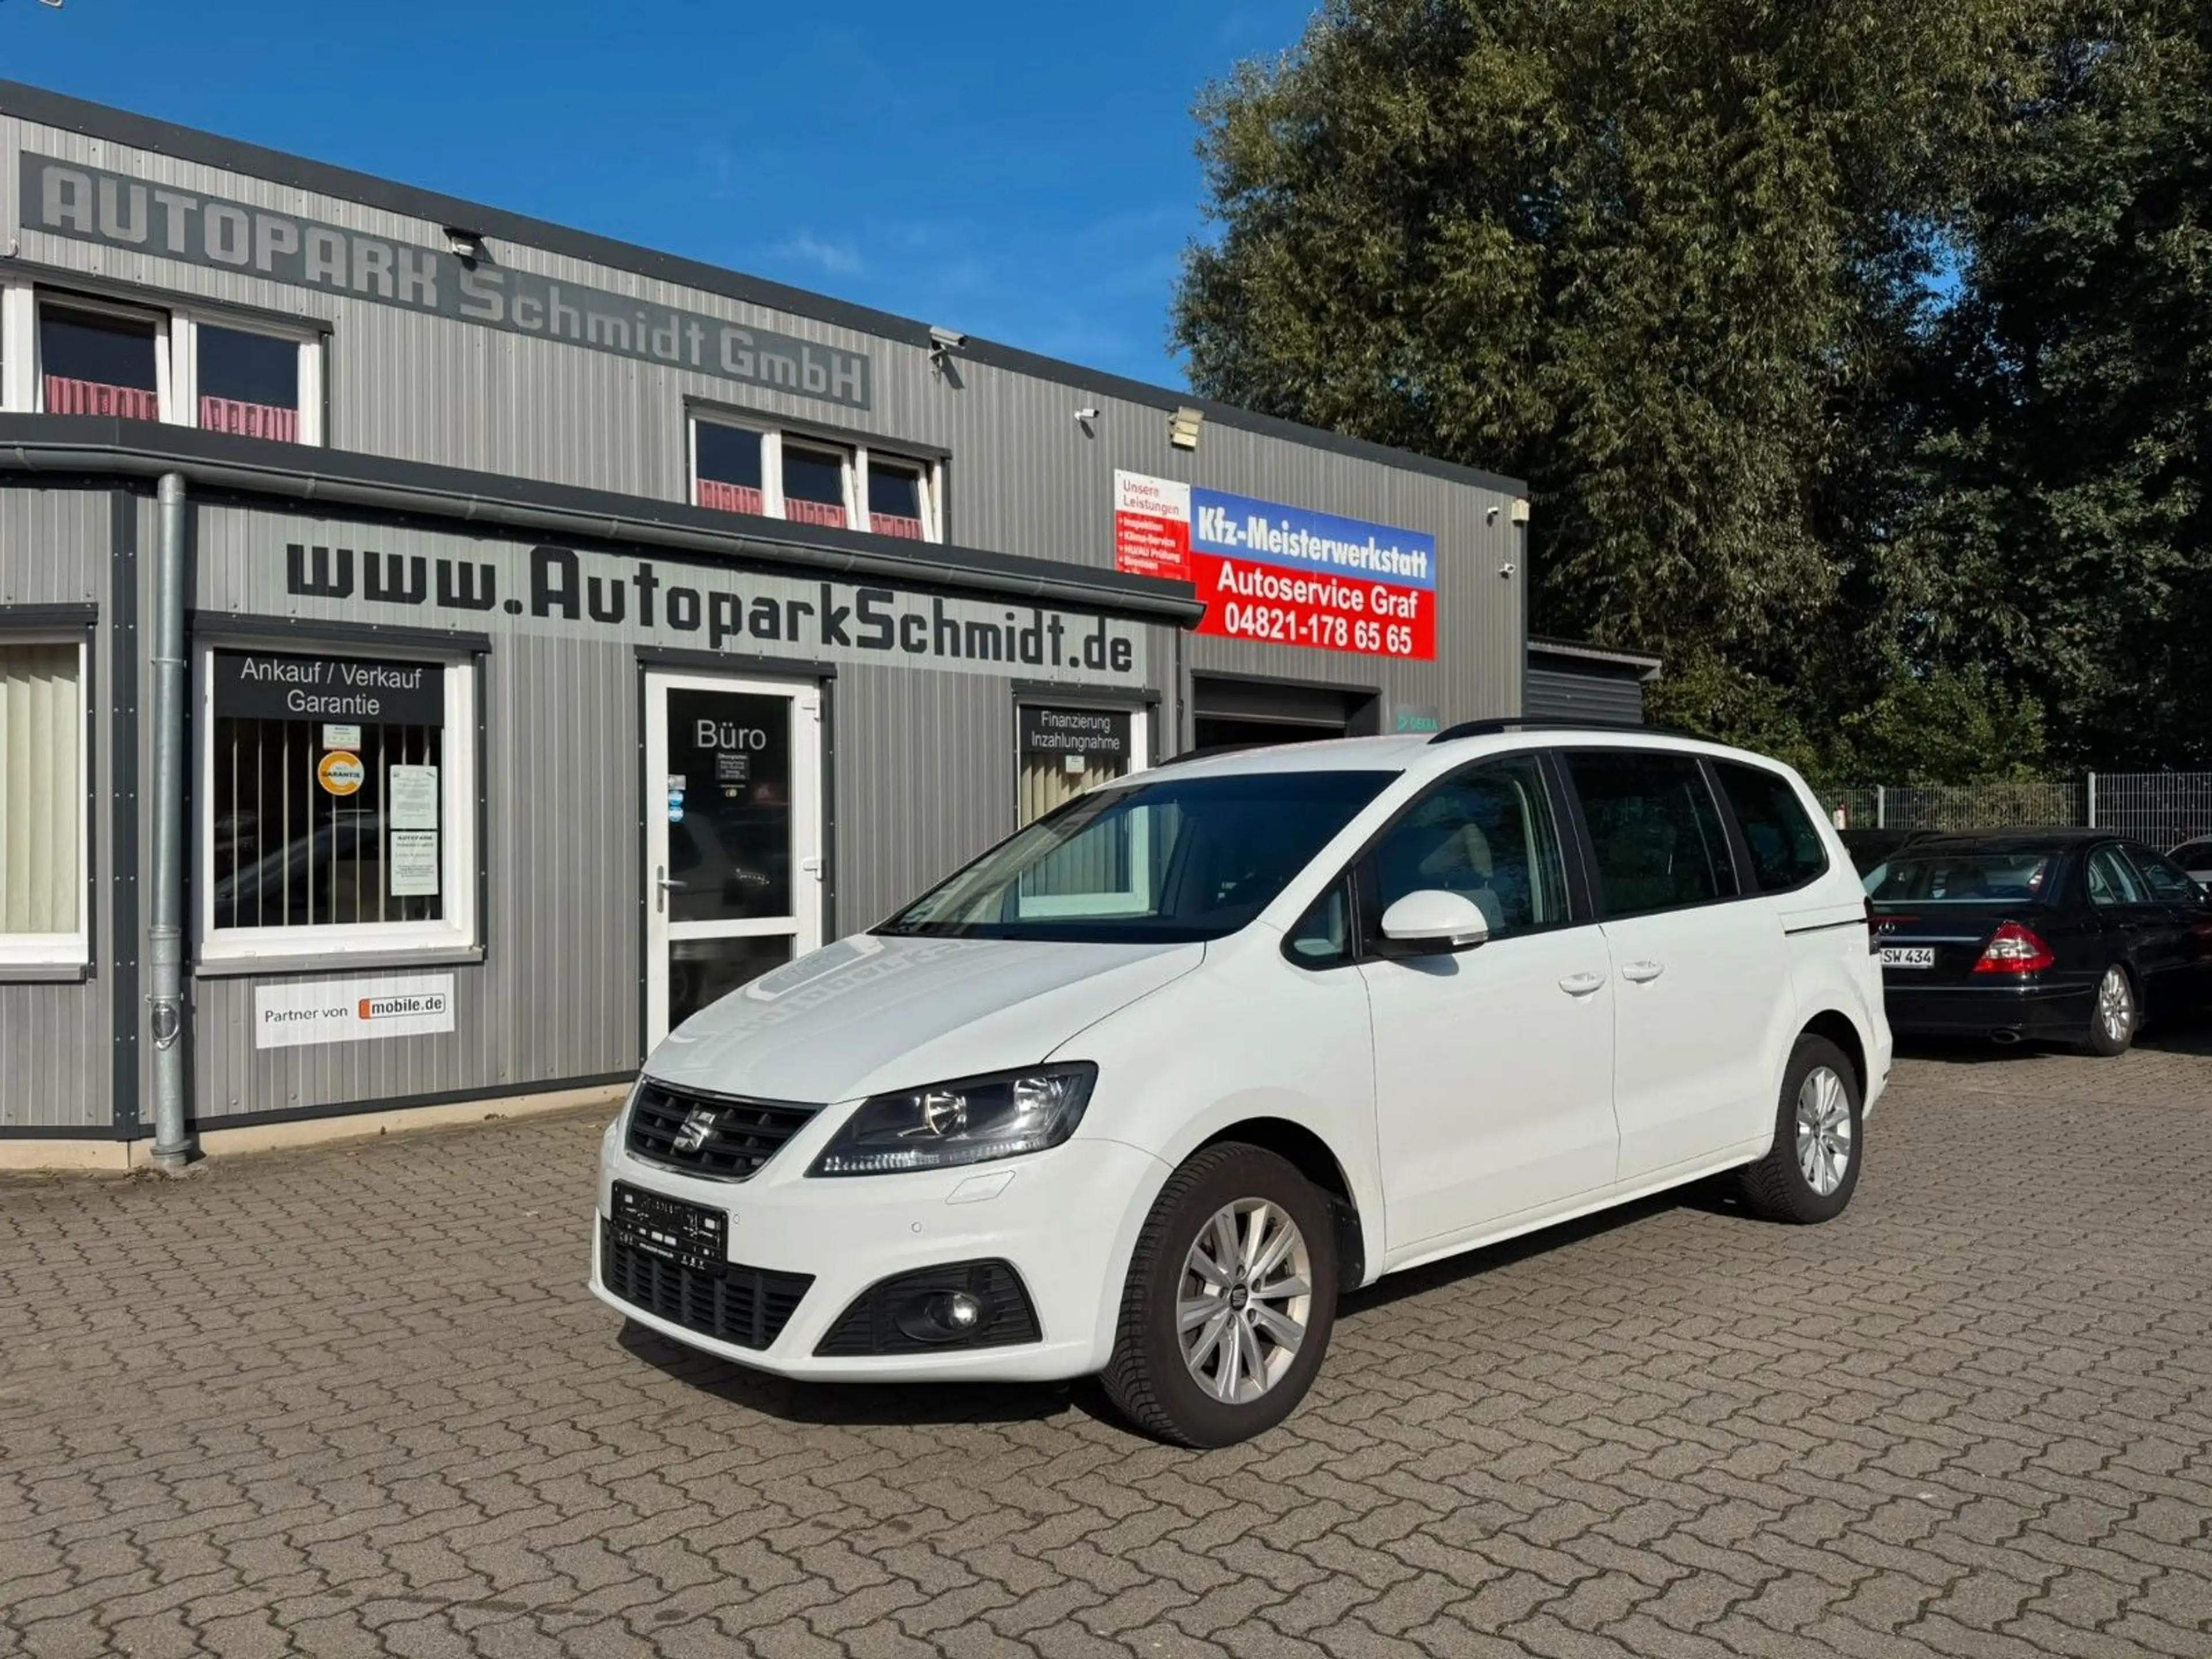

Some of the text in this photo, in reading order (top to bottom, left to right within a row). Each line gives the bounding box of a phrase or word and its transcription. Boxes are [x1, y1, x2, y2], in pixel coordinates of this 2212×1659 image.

[42, 164, 862, 402] AUTOPARK Schmidt GmbH
[1124, 479, 1159, 497] Unsere
[1124, 495, 1179, 516] Leistungen
[1198, 505, 1428, 579] Kfz-Meisterwerkstatt
[1217, 560, 1418, 619] Autoservice Graf
[286, 543, 1132, 673] www.AutoparkSchmidt.de
[1225, 602, 1412, 654] 04821-178 65 65
[241, 657, 422, 690] Ankauf / Verkauf
[287, 690, 380, 715] Garantie
[697, 719, 767, 750] Büro
[1040, 710, 1111, 733] Finanzierung
[1031, 731, 1120, 752] Inzahlungnahme
[1905, 949, 1931, 963] 434
[264, 997, 442, 1023] Partner von mobile.de
